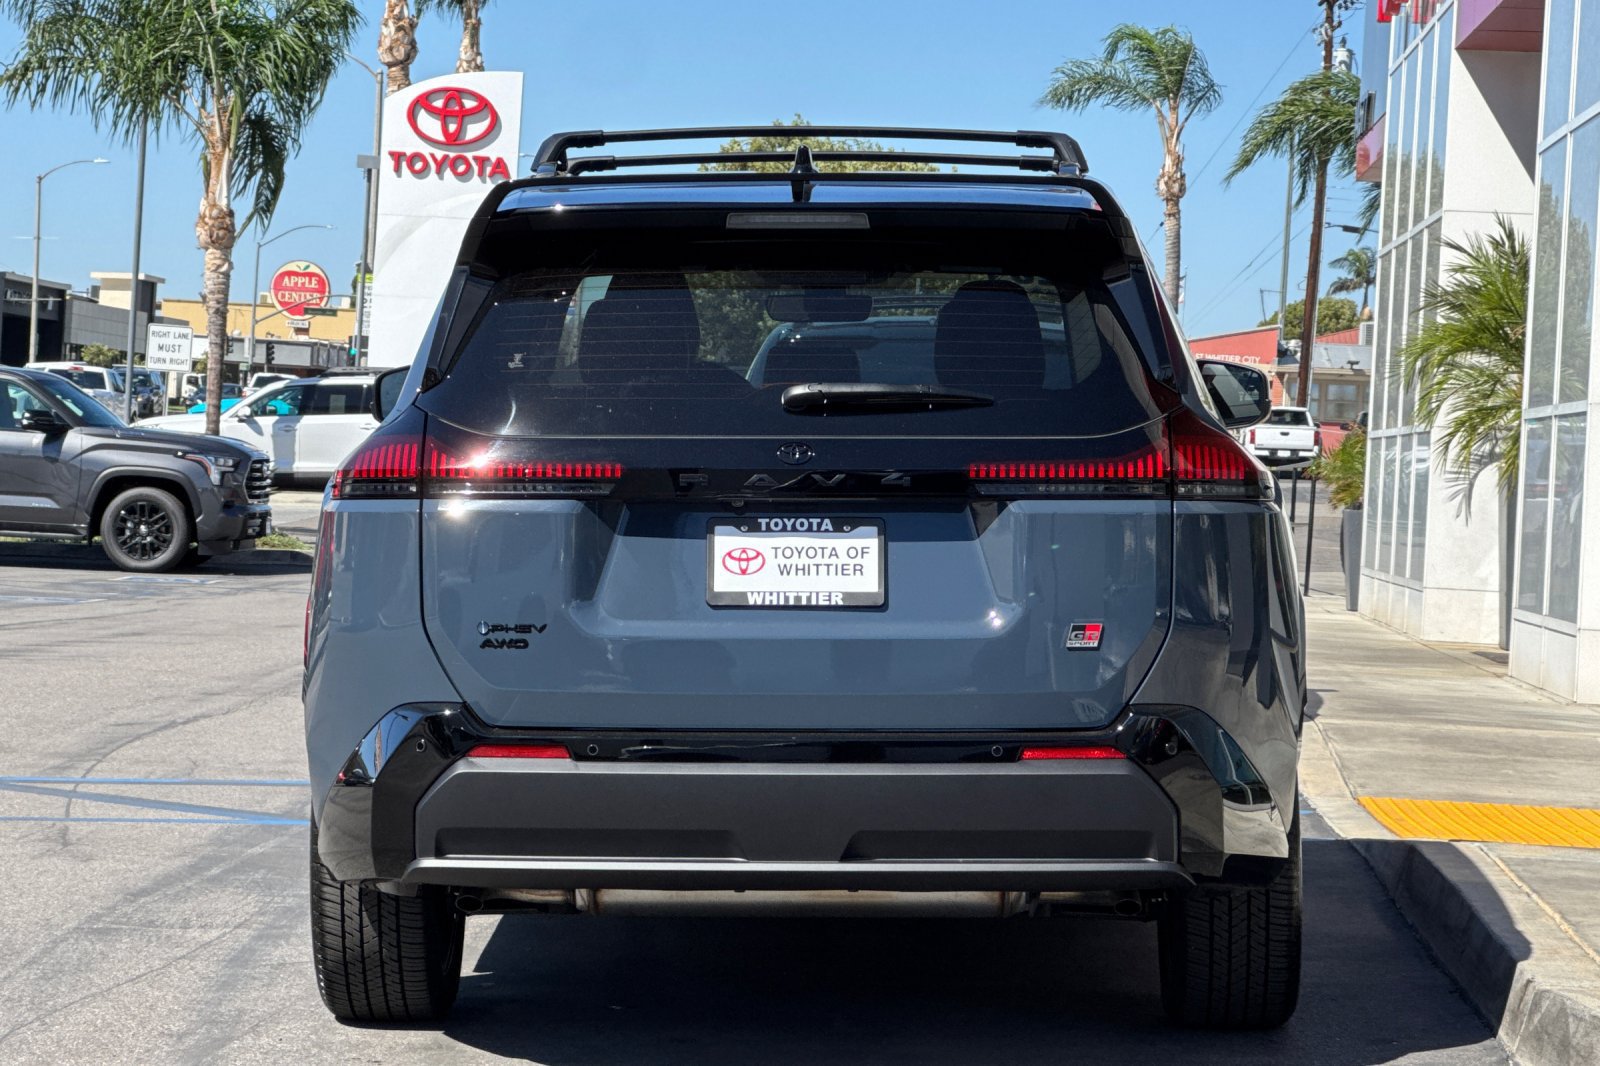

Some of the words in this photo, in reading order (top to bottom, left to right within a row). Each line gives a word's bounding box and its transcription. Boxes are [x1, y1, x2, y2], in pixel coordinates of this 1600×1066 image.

[388, 150, 512, 180] TOYOTA
[282, 276, 319, 288] APPLE
[278, 291, 321, 304] CENTER
[151, 330, 171, 338] RIGHT
[173, 332, 190, 340] LANE
[157, 343, 182, 353] MUST
[149, 356, 167, 365] TURN
[169, 357, 189, 366] RIGHT
[1242, 355, 1261, 364] CITY
[757, 518, 834, 532] TOYOTA
[771, 546, 840, 560] TOYOTA
[846, 546, 871, 560] OF
[777, 563, 864, 576] WHITTIER
[746, 591, 844, 606] WHITTIER
[490, 623, 548, 634] PHEV
[1070, 630, 1100, 641] GR
[479, 638, 530, 649] AWD
